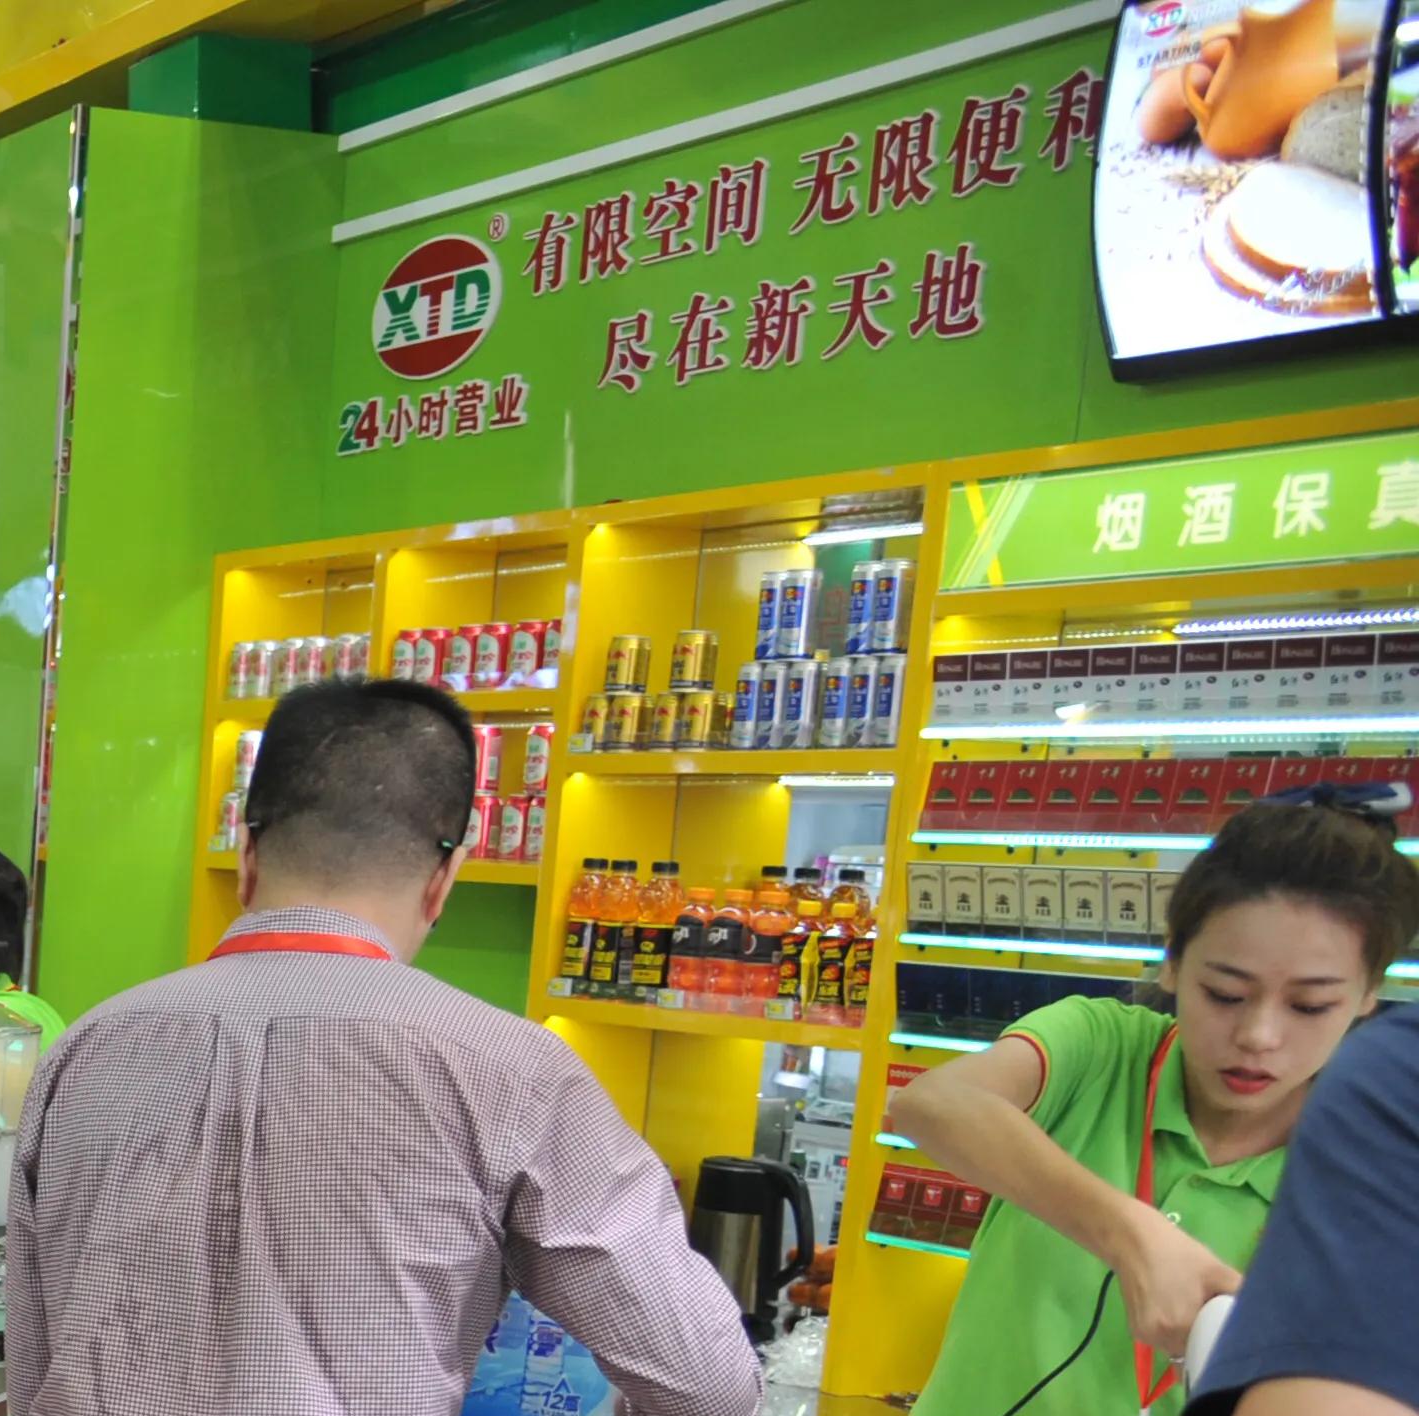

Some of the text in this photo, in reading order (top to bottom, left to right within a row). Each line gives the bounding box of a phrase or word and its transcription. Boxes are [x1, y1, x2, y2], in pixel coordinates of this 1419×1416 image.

[523, 70, 1101, 295] 有限空间 无限便利
[378, 270, 492, 348] XTD
[597, 245, 983, 391] 尽在新天地
[337, 375, 530, 455] 24小时营业
[1091, 456, 1419, 555] 烟酒保真
